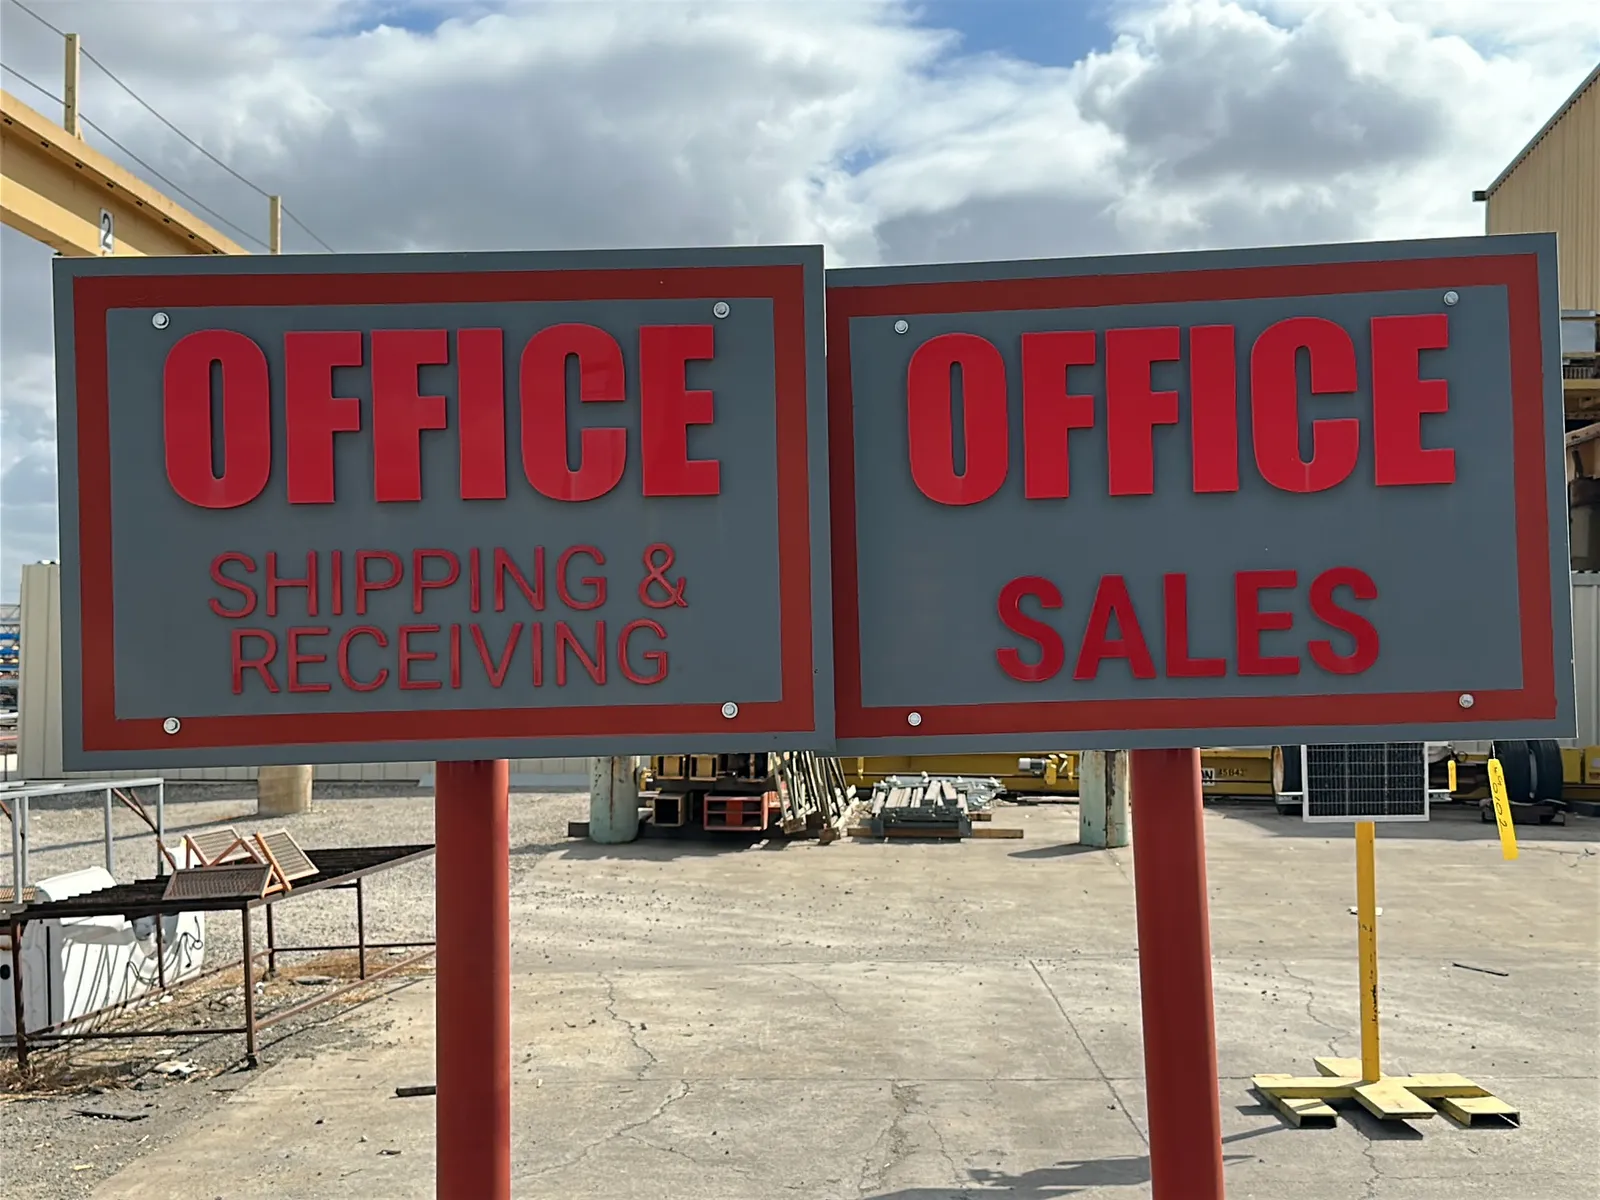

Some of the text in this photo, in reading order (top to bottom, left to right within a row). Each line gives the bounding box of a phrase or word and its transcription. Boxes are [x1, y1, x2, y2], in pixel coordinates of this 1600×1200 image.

[102, 213, 112, 250] 2
[163, 323, 720, 508] OFFICE
[907, 313, 1456, 506] OFFICE
[209, 543, 688, 618] SHIPPING &
[996, 566, 1380, 682] SALES
[230, 618, 668, 694] RECEIVING
